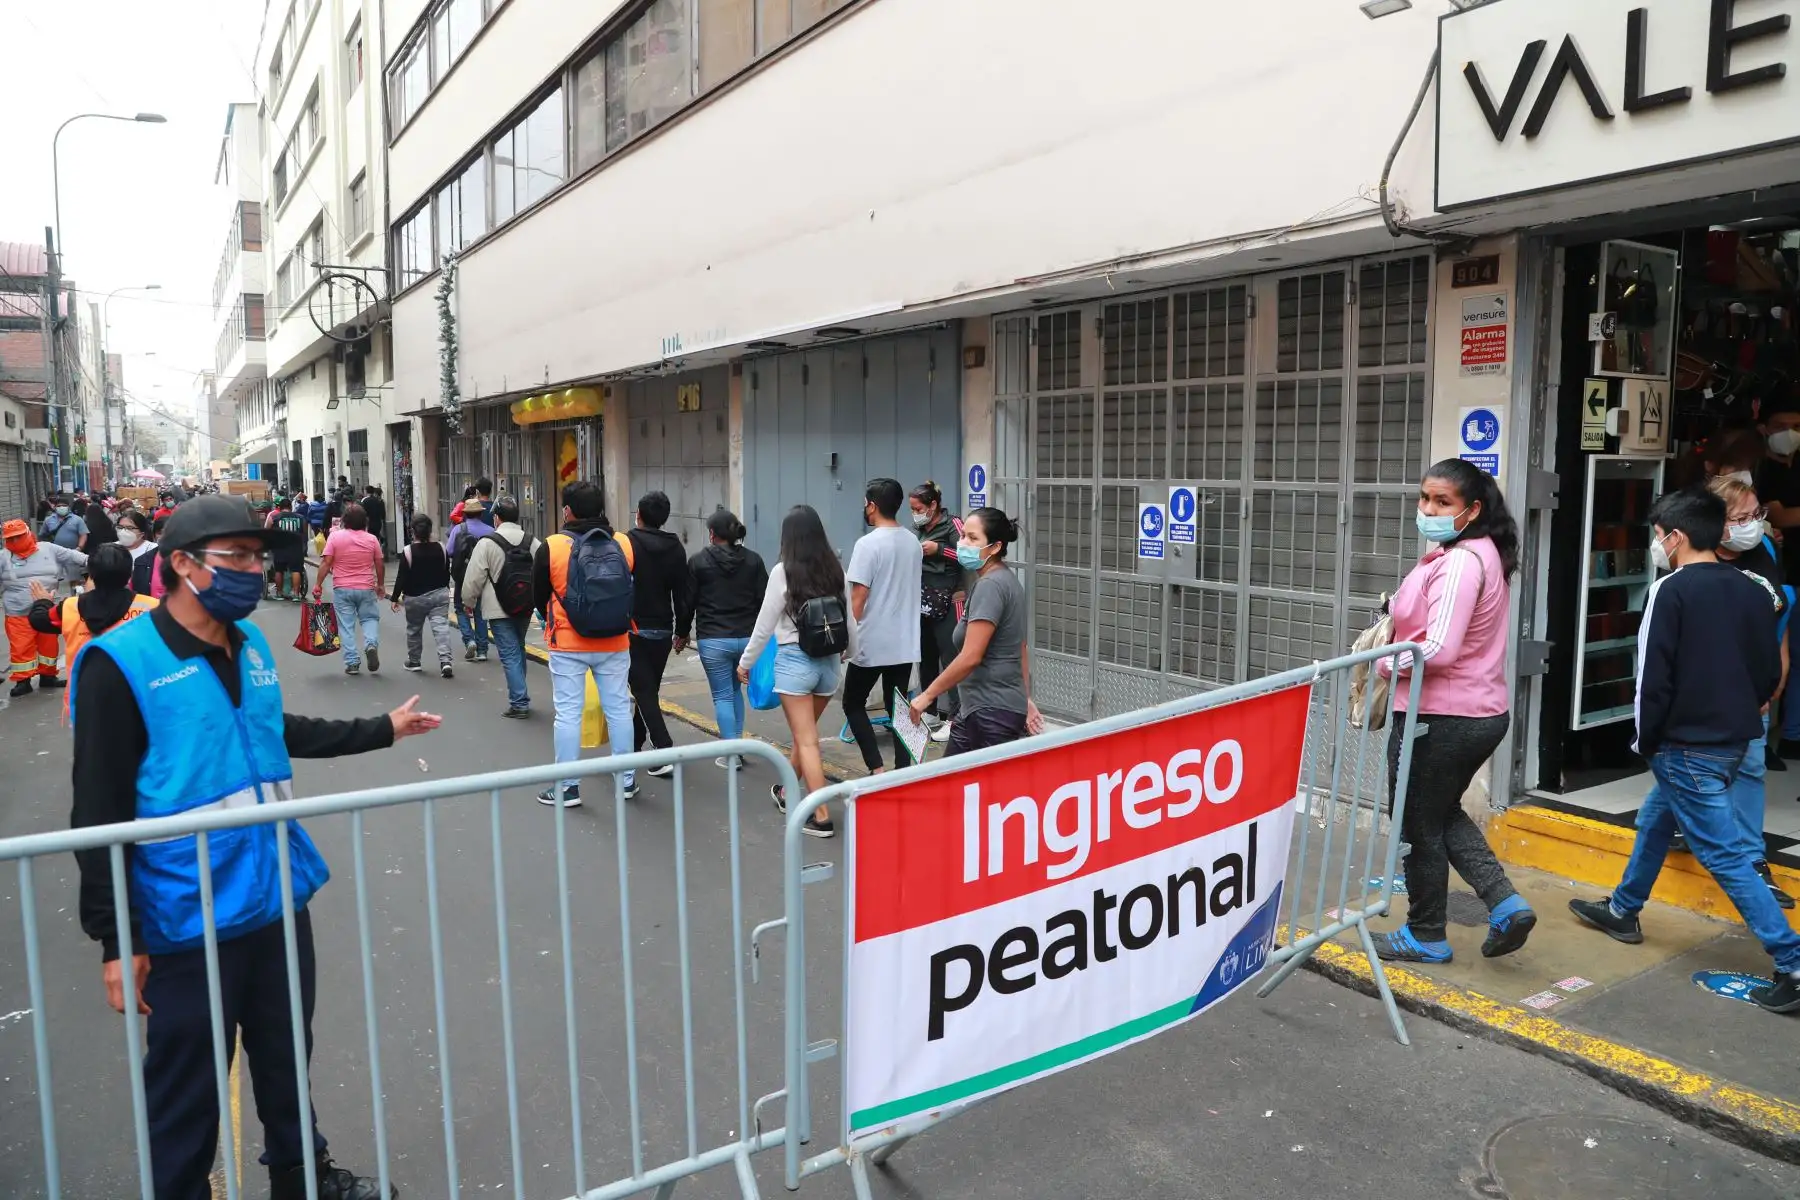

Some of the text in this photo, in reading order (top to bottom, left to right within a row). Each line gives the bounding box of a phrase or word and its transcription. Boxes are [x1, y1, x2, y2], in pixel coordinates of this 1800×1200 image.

[1462, 0, 1791, 142] VALE
[1456, 263, 1492, 283] 904
[1463, 310, 1506, 322] verisure
[1463, 329, 1506, 341] Alarma
[1584, 432, 1604, 442] SALIDA
[963, 738, 1244, 883] Ingreso
[926, 822, 1258, 1041] peatonal
